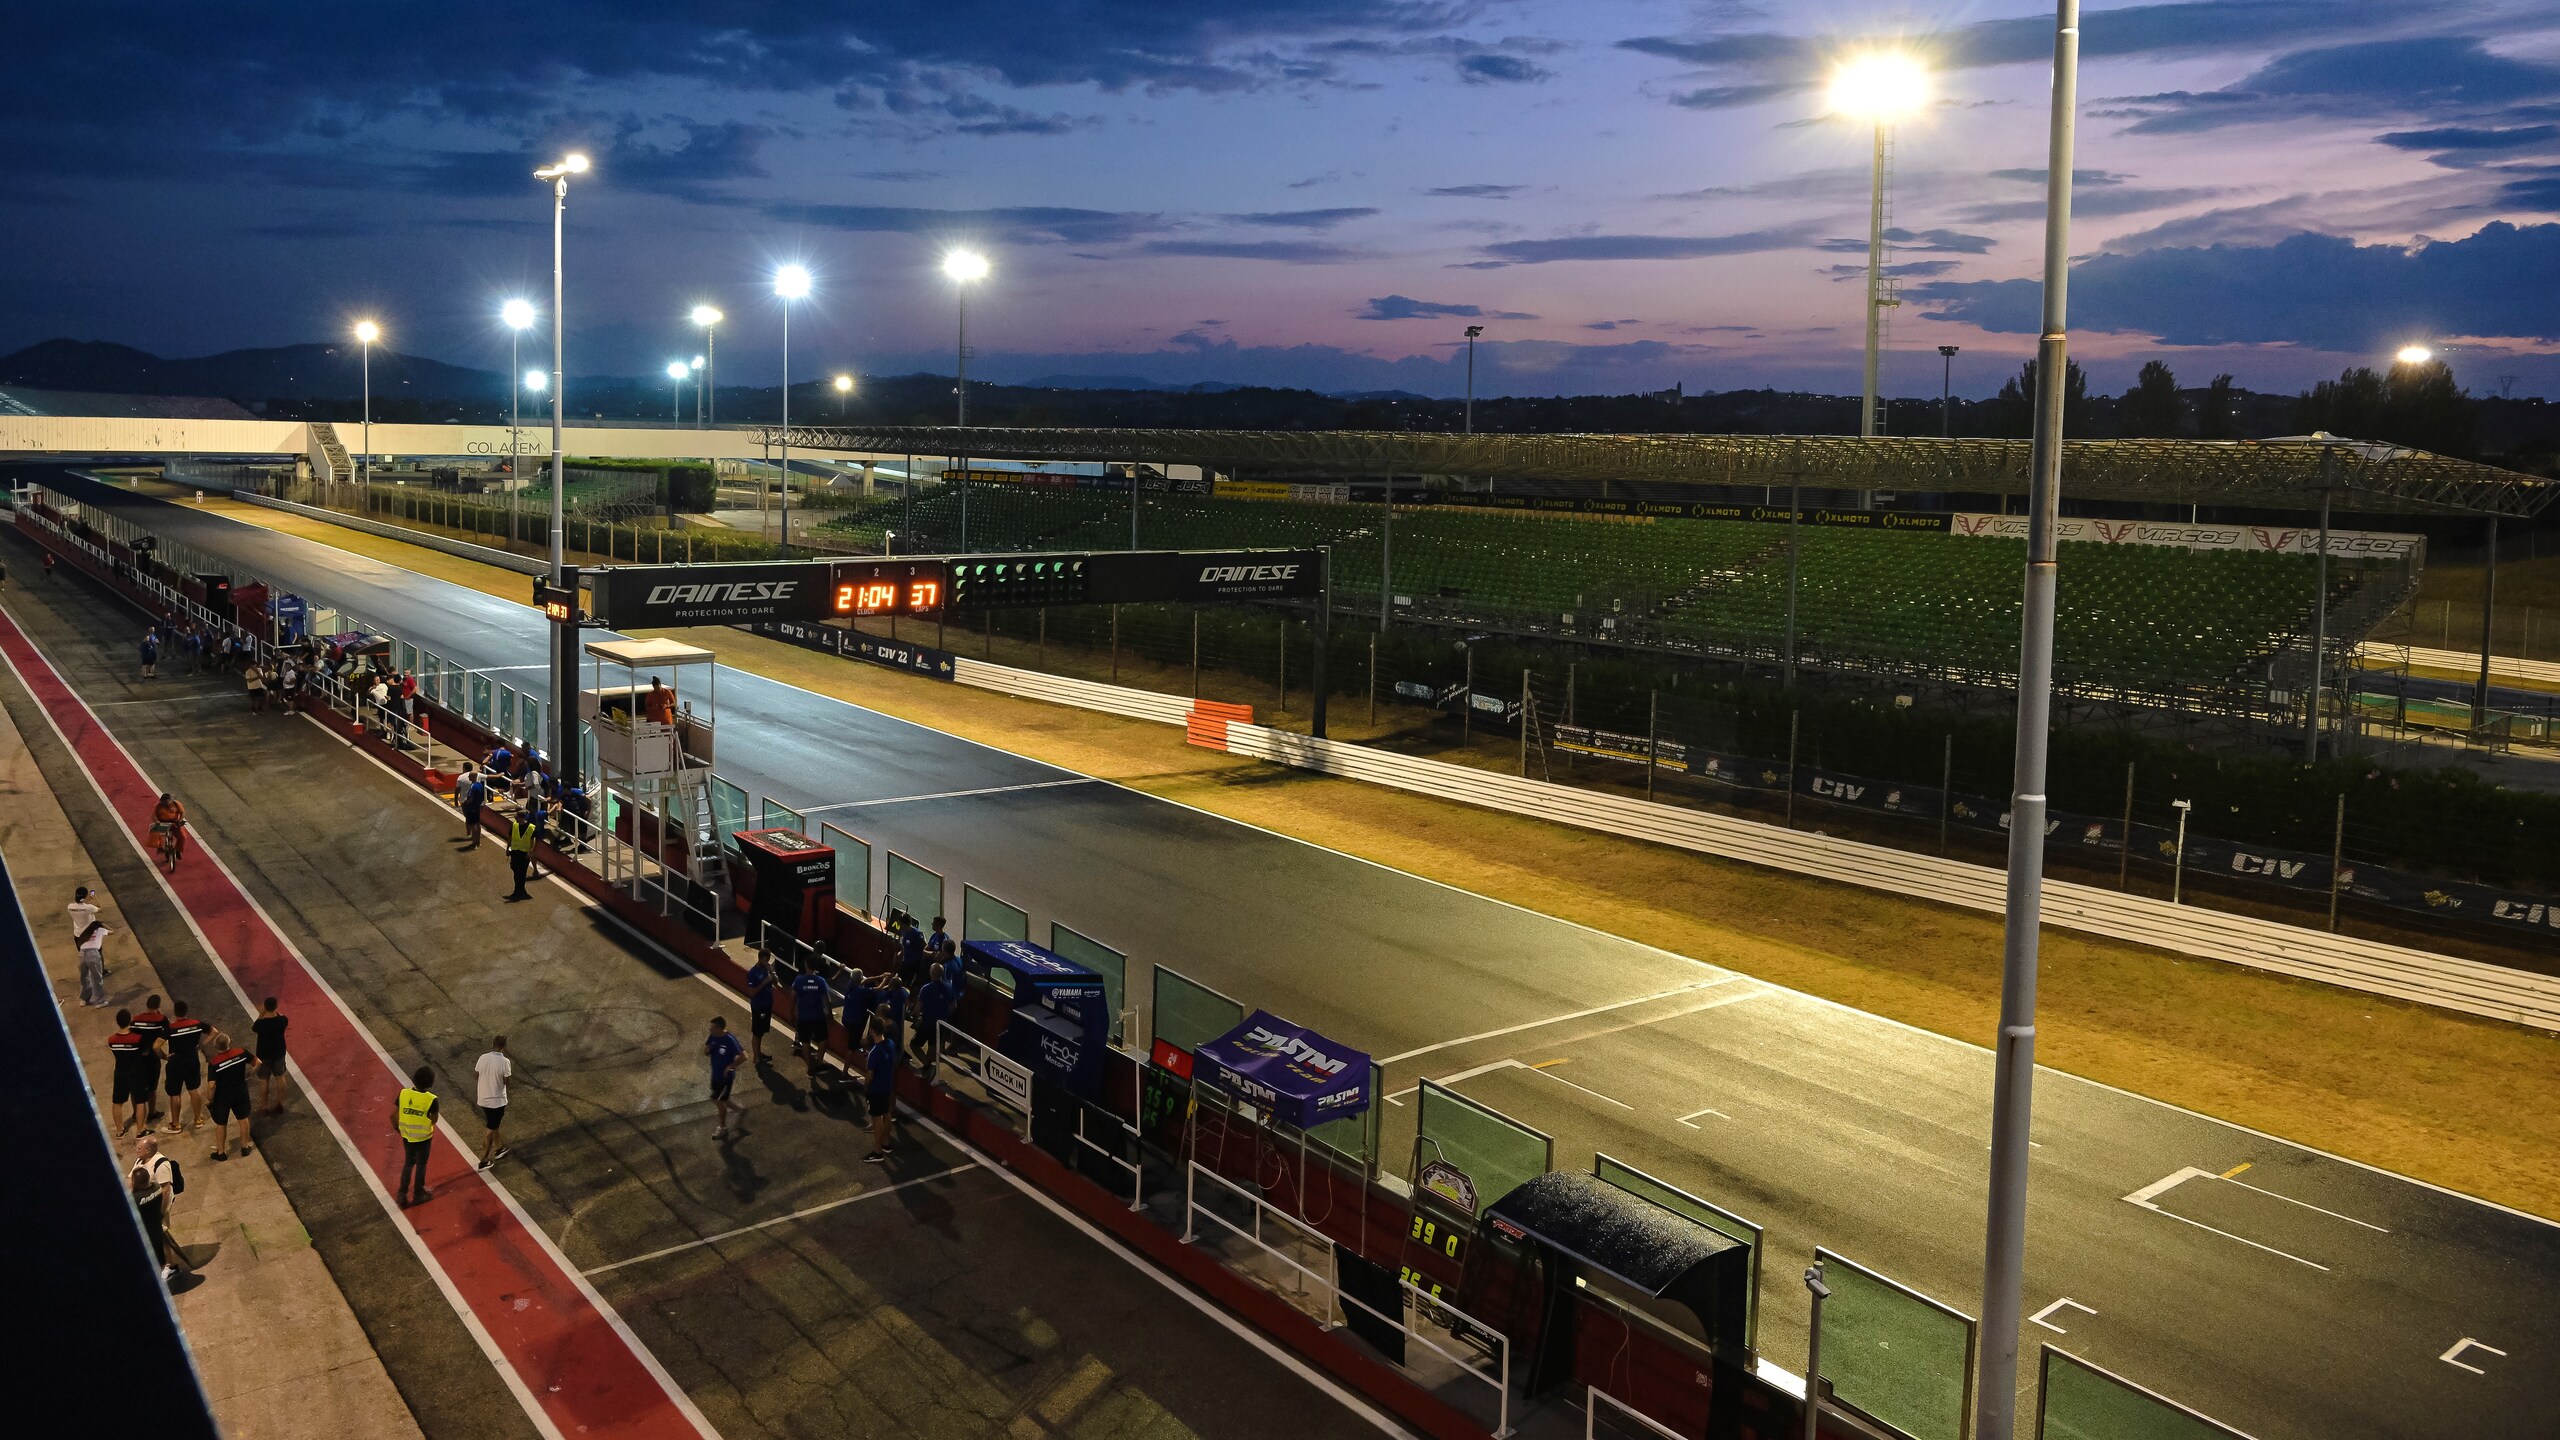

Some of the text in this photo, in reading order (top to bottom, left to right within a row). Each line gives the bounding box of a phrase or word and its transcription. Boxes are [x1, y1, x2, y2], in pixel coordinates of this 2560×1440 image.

[1649, 505, 1682, 514] XLMOTO
[1703, 508, 1741, 517] XLMOTO
[1766, 511, 1804, 520] XLMOO
[1830, 514, 1870, 524] XLMOTO
[1899, 518, 1941, 527] XLMOTO
[1994, 520, 2084, 536] VIROS
[2137, 527, 2240, 545] VIRCOS
[2301, 534, 2419, 552] VRCOS
[874, 568, 879, 577] 2
[910, 567, 915, 576] 3
[1199, 564, 1300, 582] DAINESE
[646, 581, 798, 604] DAINESE
[838, 585, 894, 609] 21:04
[910, 584, 937, 606] 37
[676, 608, 734, 617] PROTECTION
[737, 607, 748, 615] TO
[781, 623, 795, 635] CIV
[878, 646, 897, 660] CIV
[1812, 777, 1866, 801] CIV
[1999, 813, 2061, 836] CV
[2232, 852, 2306, 879] CIV
[1059, 988, 1082, 996] YAMAHA
[992, 1065, 1024, 1091] TRACK IN
[1412, 1216, 1435, 1245] 39
